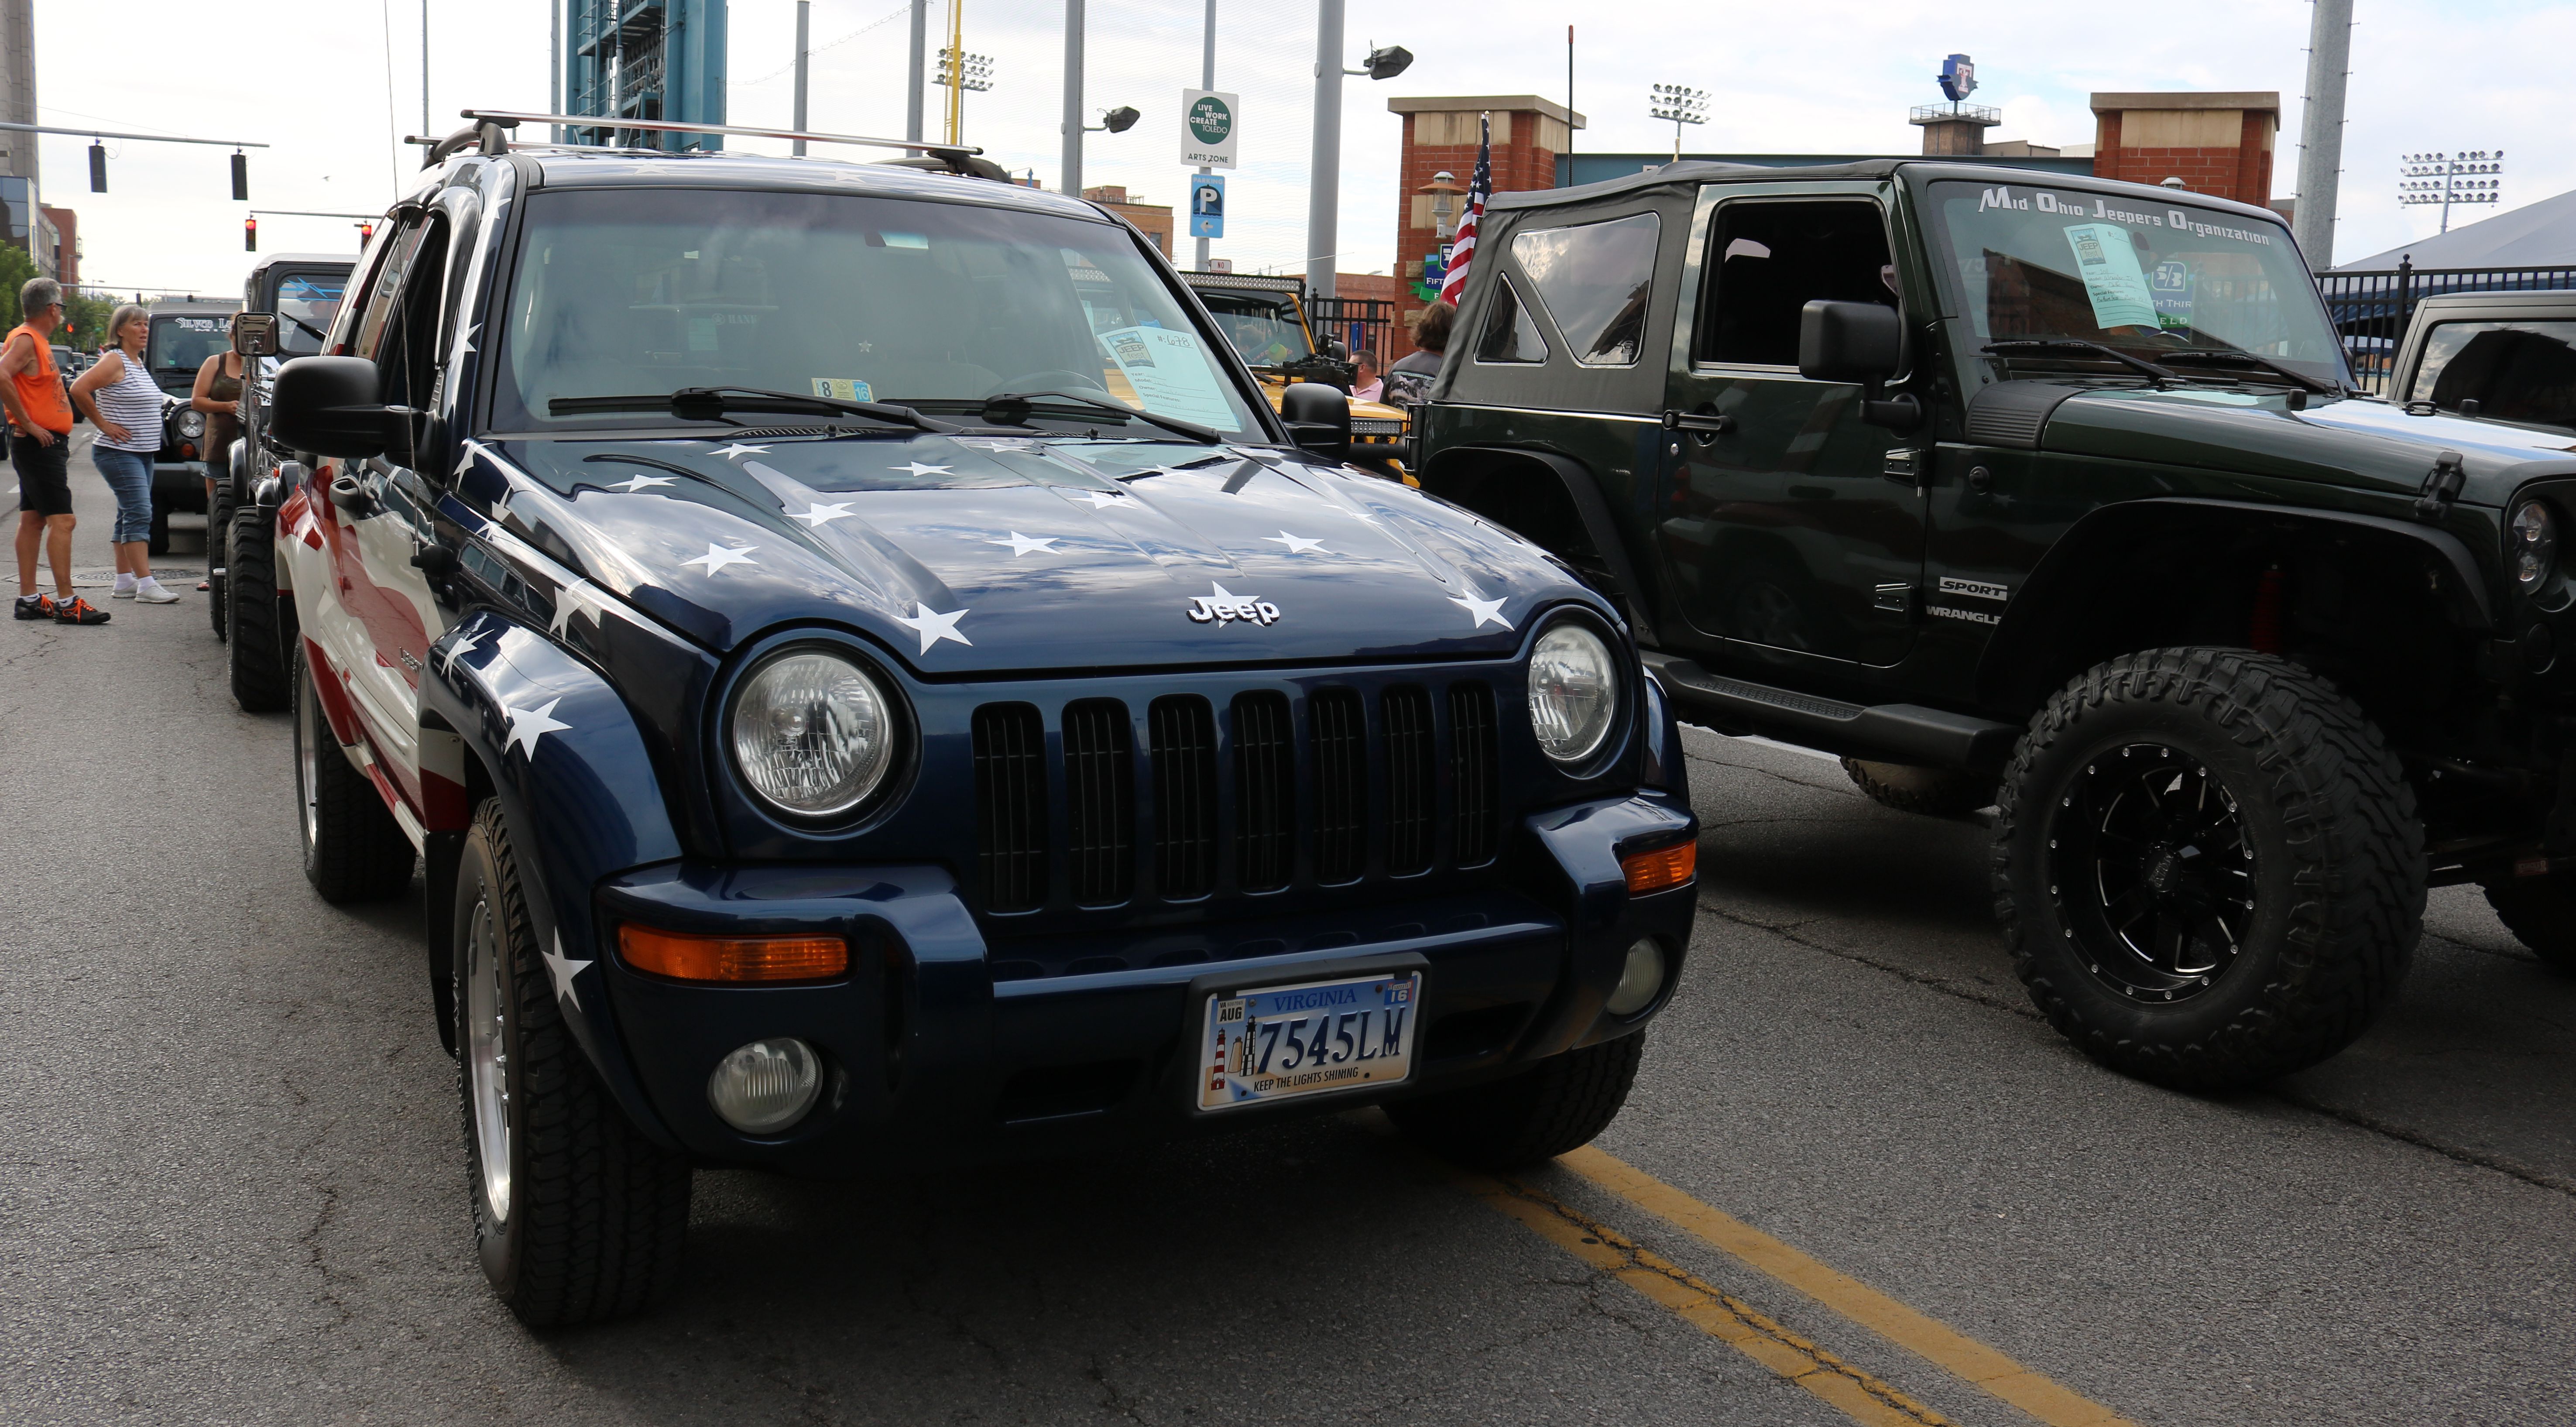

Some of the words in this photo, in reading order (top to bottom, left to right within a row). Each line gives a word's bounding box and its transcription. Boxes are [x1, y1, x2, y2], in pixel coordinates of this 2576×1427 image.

[1190, 117, 1217, 125] CREATE
[1205, 112, 1227, 120] WORK
[1202, 125, 1227, 134] TOLEDO
[1188, 153, 1206, 161] ARTS
[1209, 155, 1228, 163] ZONE
[1200, 188, 1217, 212] P
[2092, 199, 2161, 226] Jeepers
[2168, 210, 2269, 245] Organization
[2079, 242, 2098, 250] JEEP
[1119, 344, 1144, 353] JEEP
[1166, 335, 1190, 347] 678
[821, 381, 832, 397] 8
[854, 387, 869, 400] 16
[1942, 581, 2007, 597] SPORT
[1186, 600, 1280, 626] Jeep
[1926, 605, 2002, 625] WRANGLE
[1274, 989, 1356, 1012] VIRGINIA
[1391, 990, 1408, 1002] 16
[1220, 1007, 1242, 1022] AUG
[1257, 1007, 1405, 1074] 7545LM
[1254, 1080, 1274, 1092] KEEP
[1276, 1077, 1291, 1088] THE
[1293, 1072, 1322, 1086] LIGHTS
[1324, 1067, 1359, 1082] SHINING
